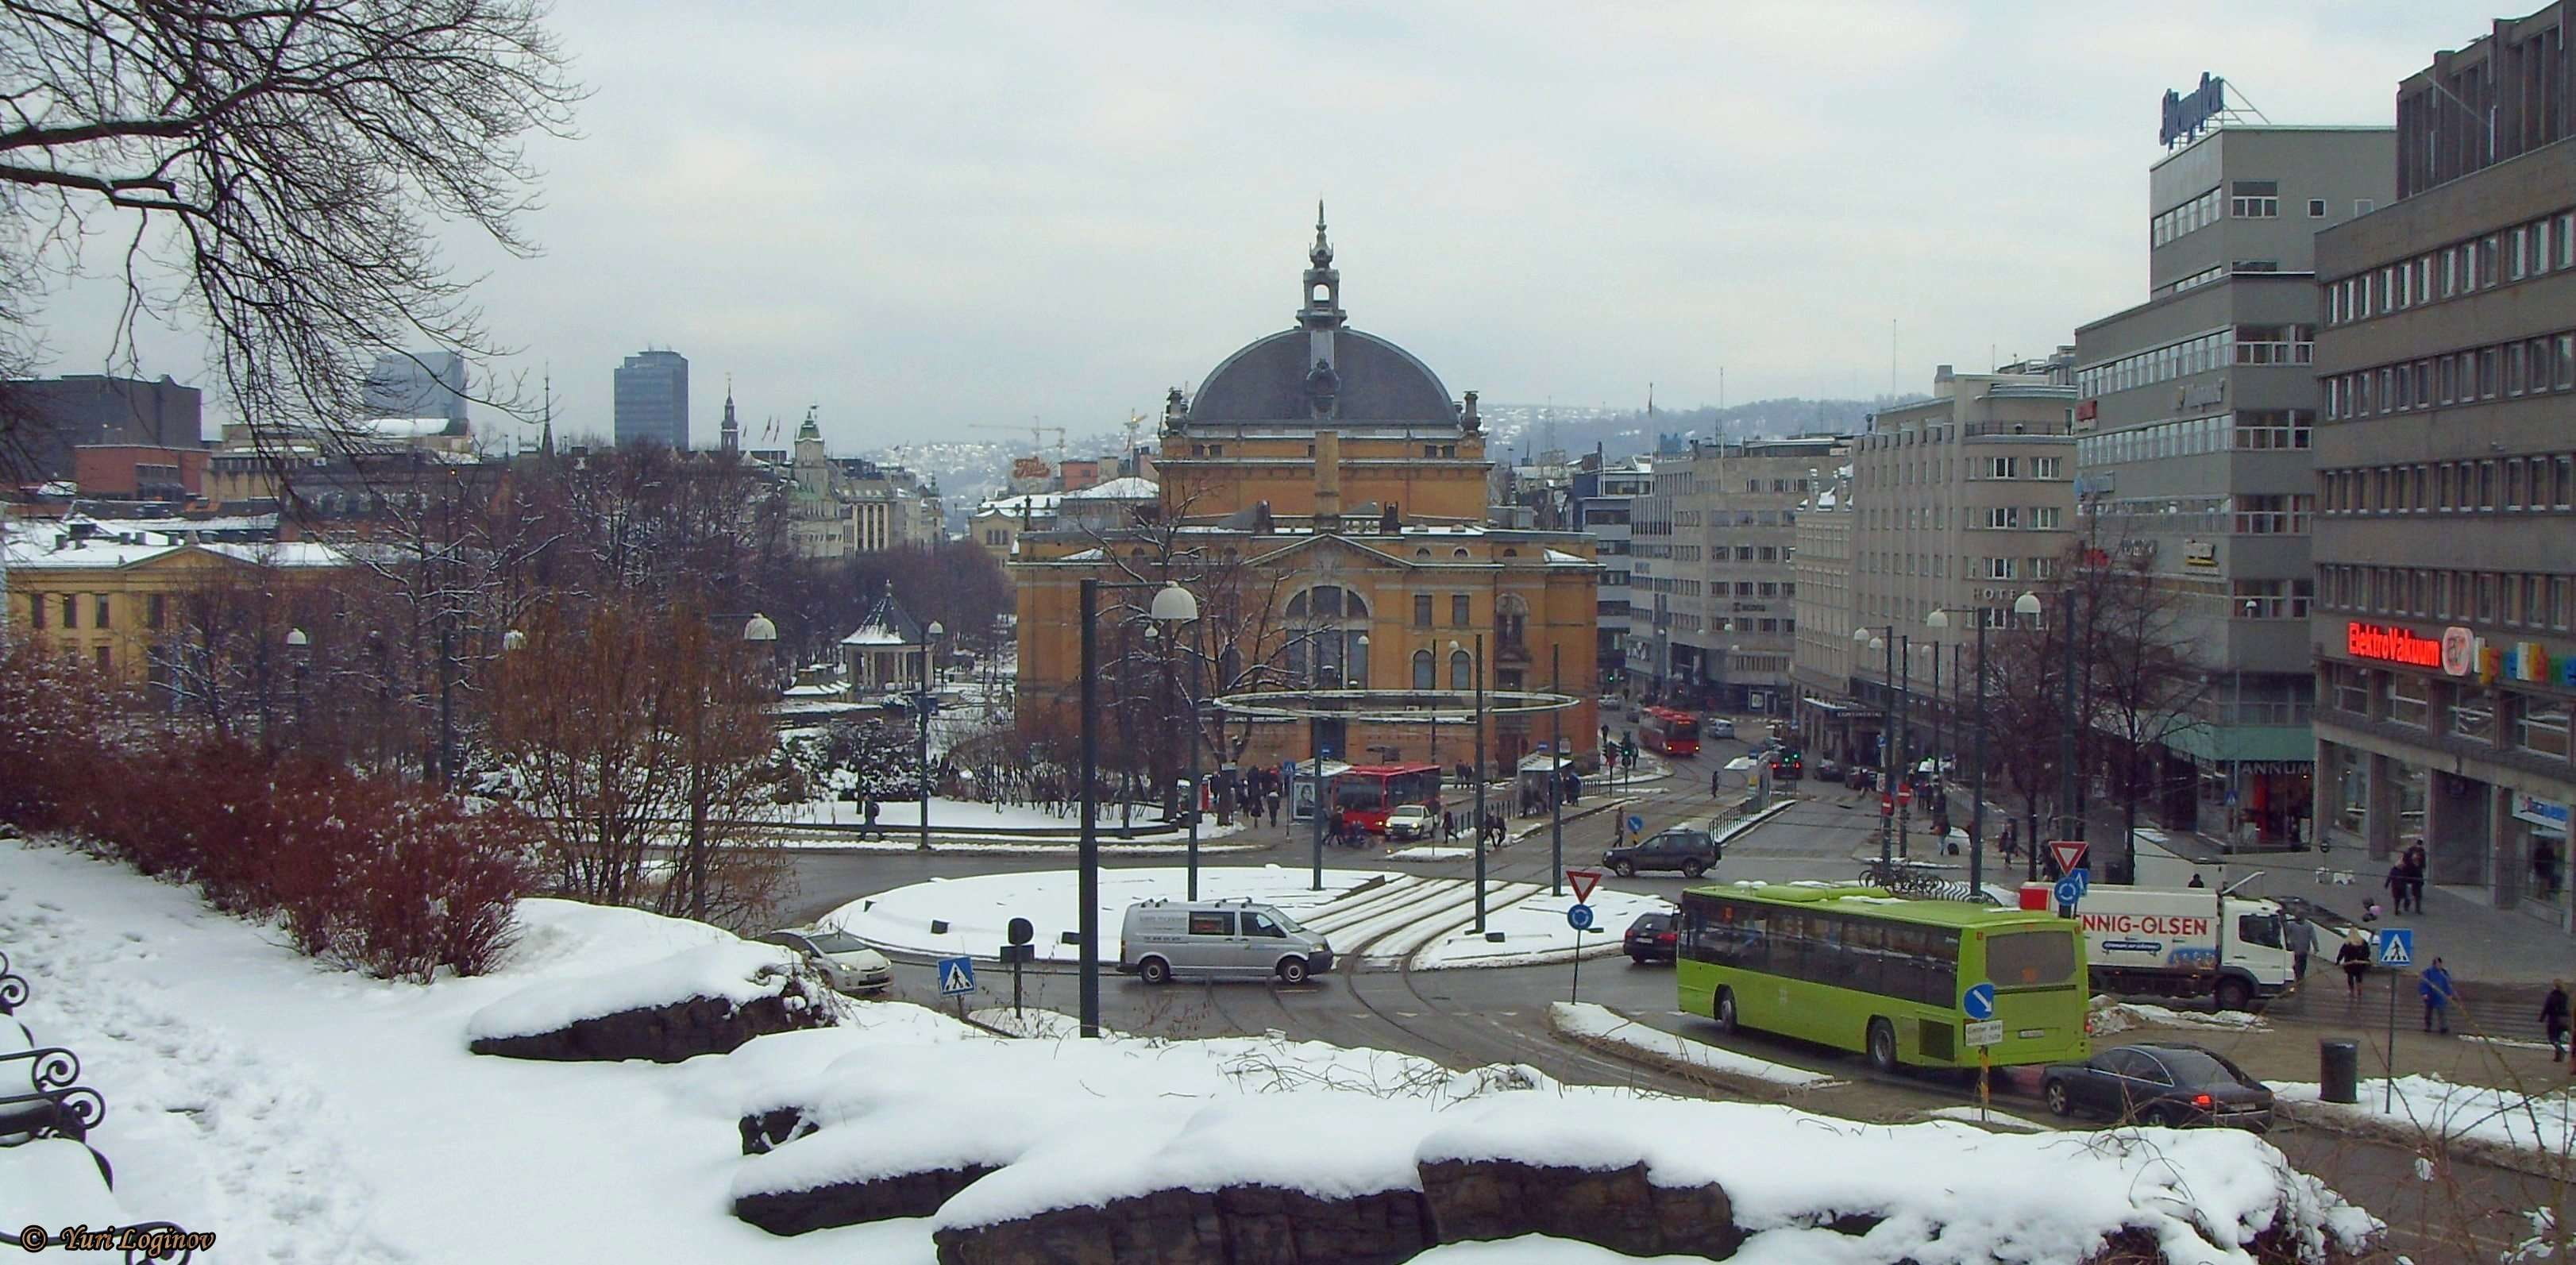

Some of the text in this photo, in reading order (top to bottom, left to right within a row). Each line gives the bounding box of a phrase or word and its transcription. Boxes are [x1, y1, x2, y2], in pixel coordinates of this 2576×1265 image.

[1973, 588, 2017, 600] HOTE
[2348, 622, 2441, 669] ElektroVakuum
[2078, 914, 2208, 935] NNIG-OLSEN
